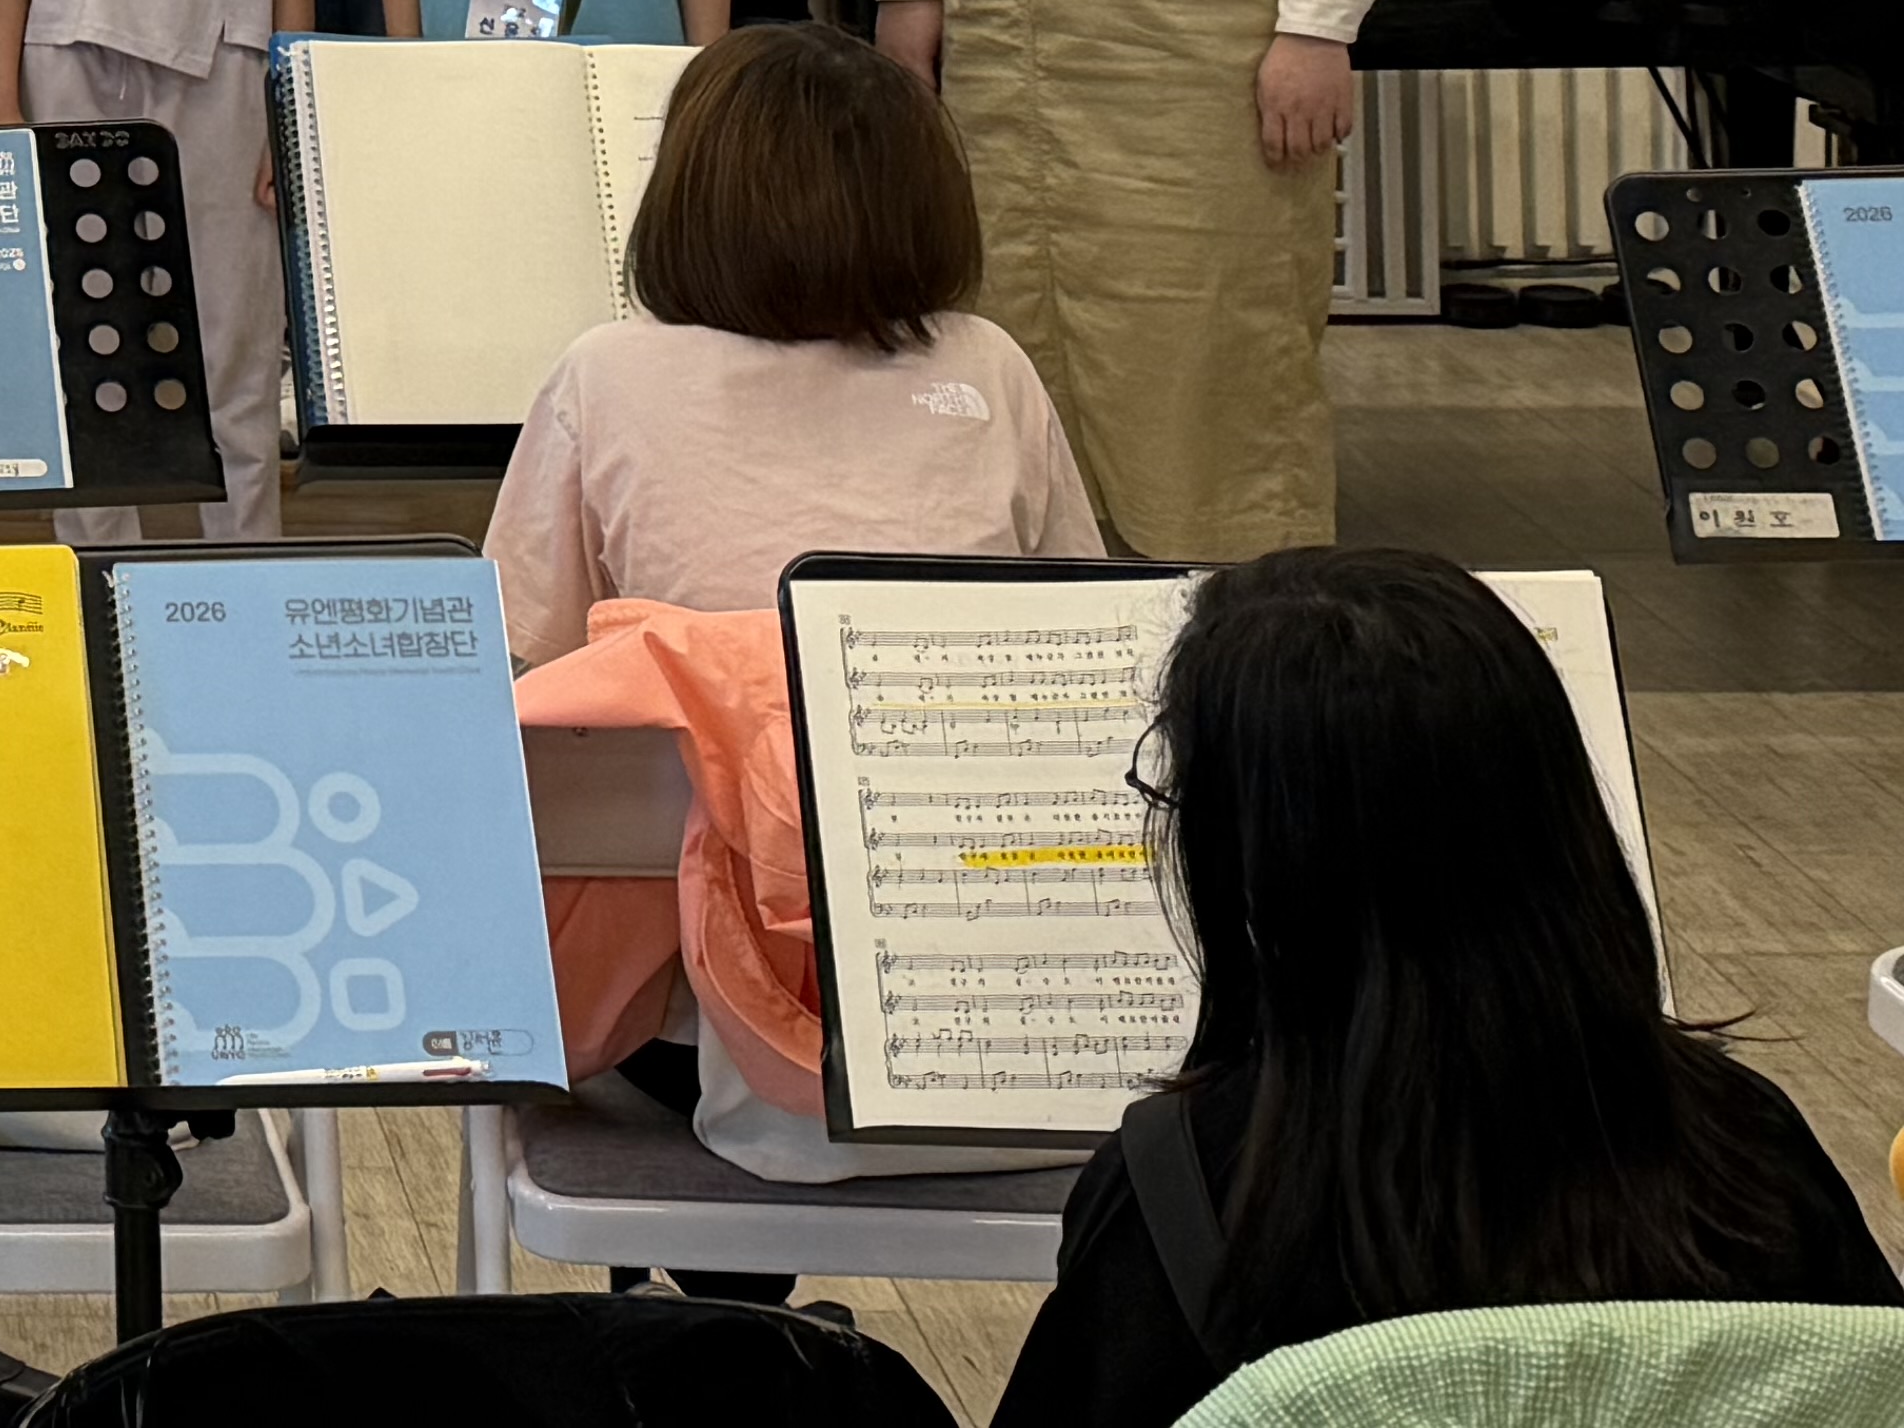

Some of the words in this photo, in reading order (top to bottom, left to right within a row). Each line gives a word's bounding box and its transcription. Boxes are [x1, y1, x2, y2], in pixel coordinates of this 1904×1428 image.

[164, 601, 228, 623] 2026
[285, 596, 474, 626] 유엔평화기념관
[288, 629, 479, 659] 소년소녀합창단
